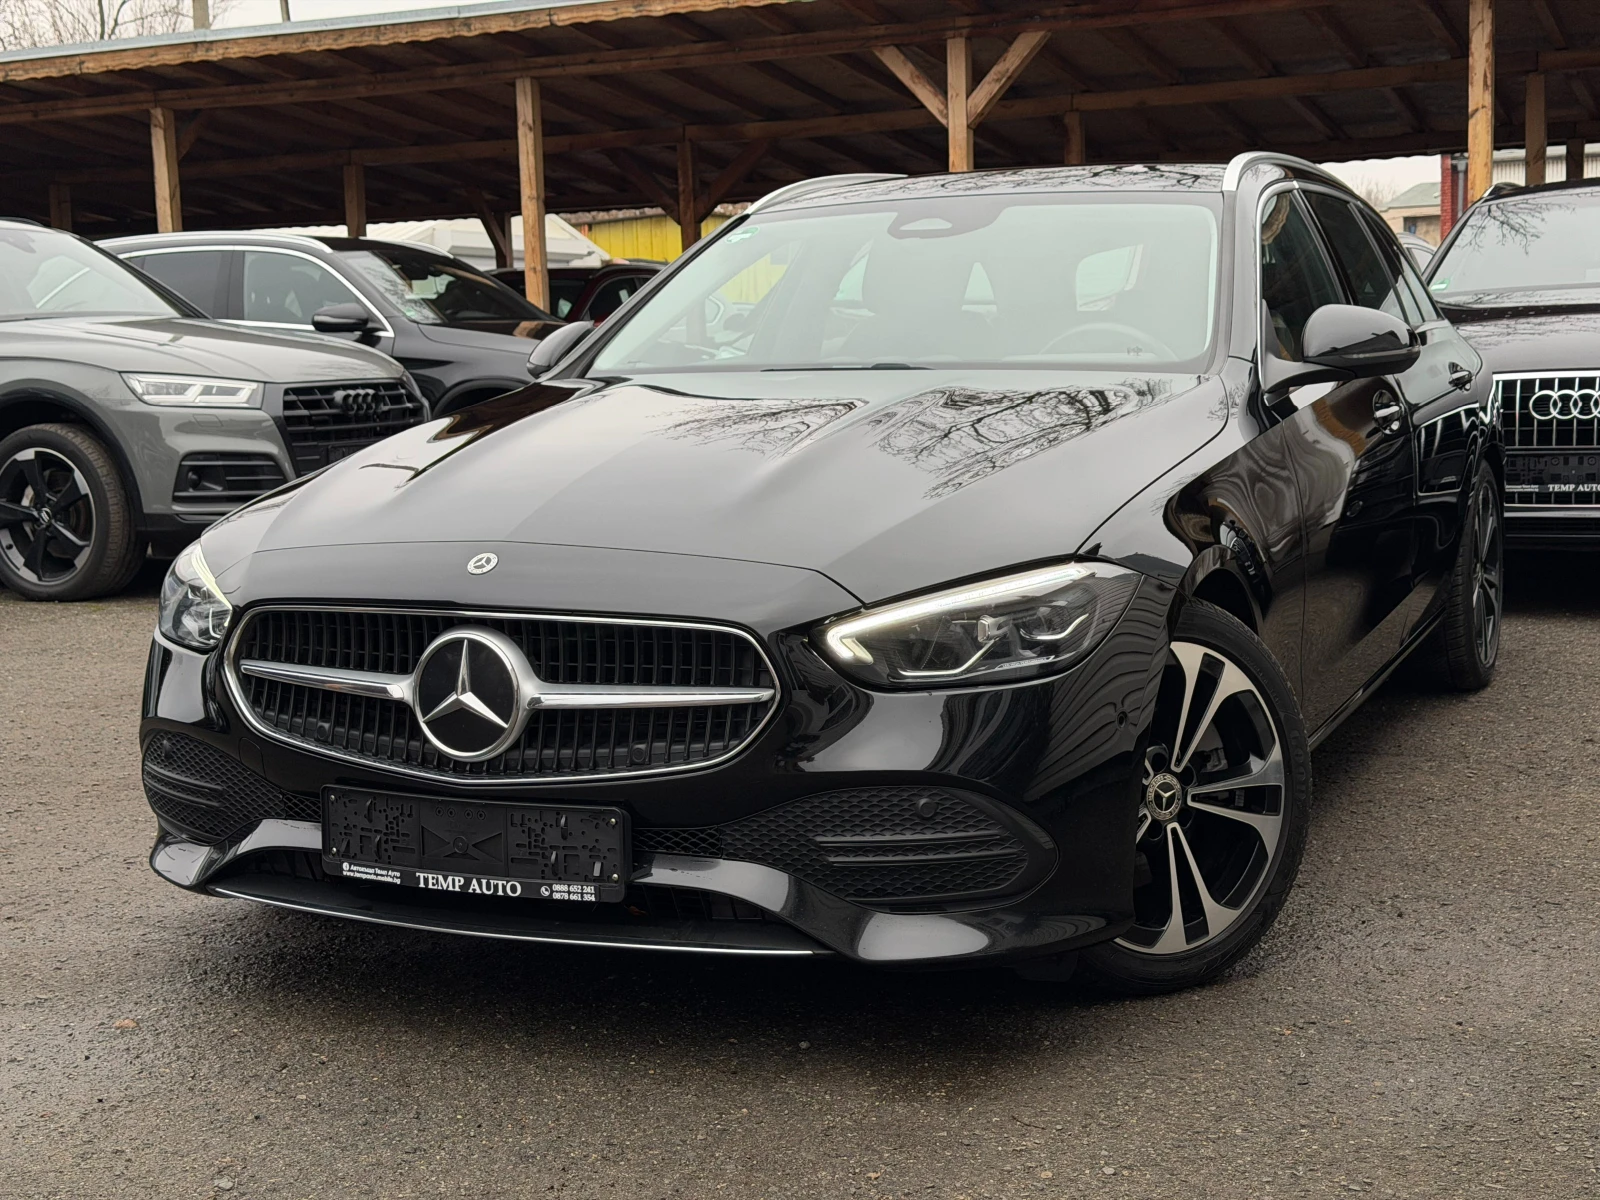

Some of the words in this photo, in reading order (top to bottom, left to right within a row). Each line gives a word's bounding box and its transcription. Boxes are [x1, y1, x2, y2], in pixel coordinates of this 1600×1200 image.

[1547, 483, 1575, 492] TEMP
[415, 872, 465, 892] TEMP
[468, 877, 522, 897] AUTO
[552, 883, 569, 892] 0888
[569, 884, 582, 893] 652
[582, 885, 595, 894] 241
[552, 891, 569, 900] 0878
[569, 892, 582, 901] 661
